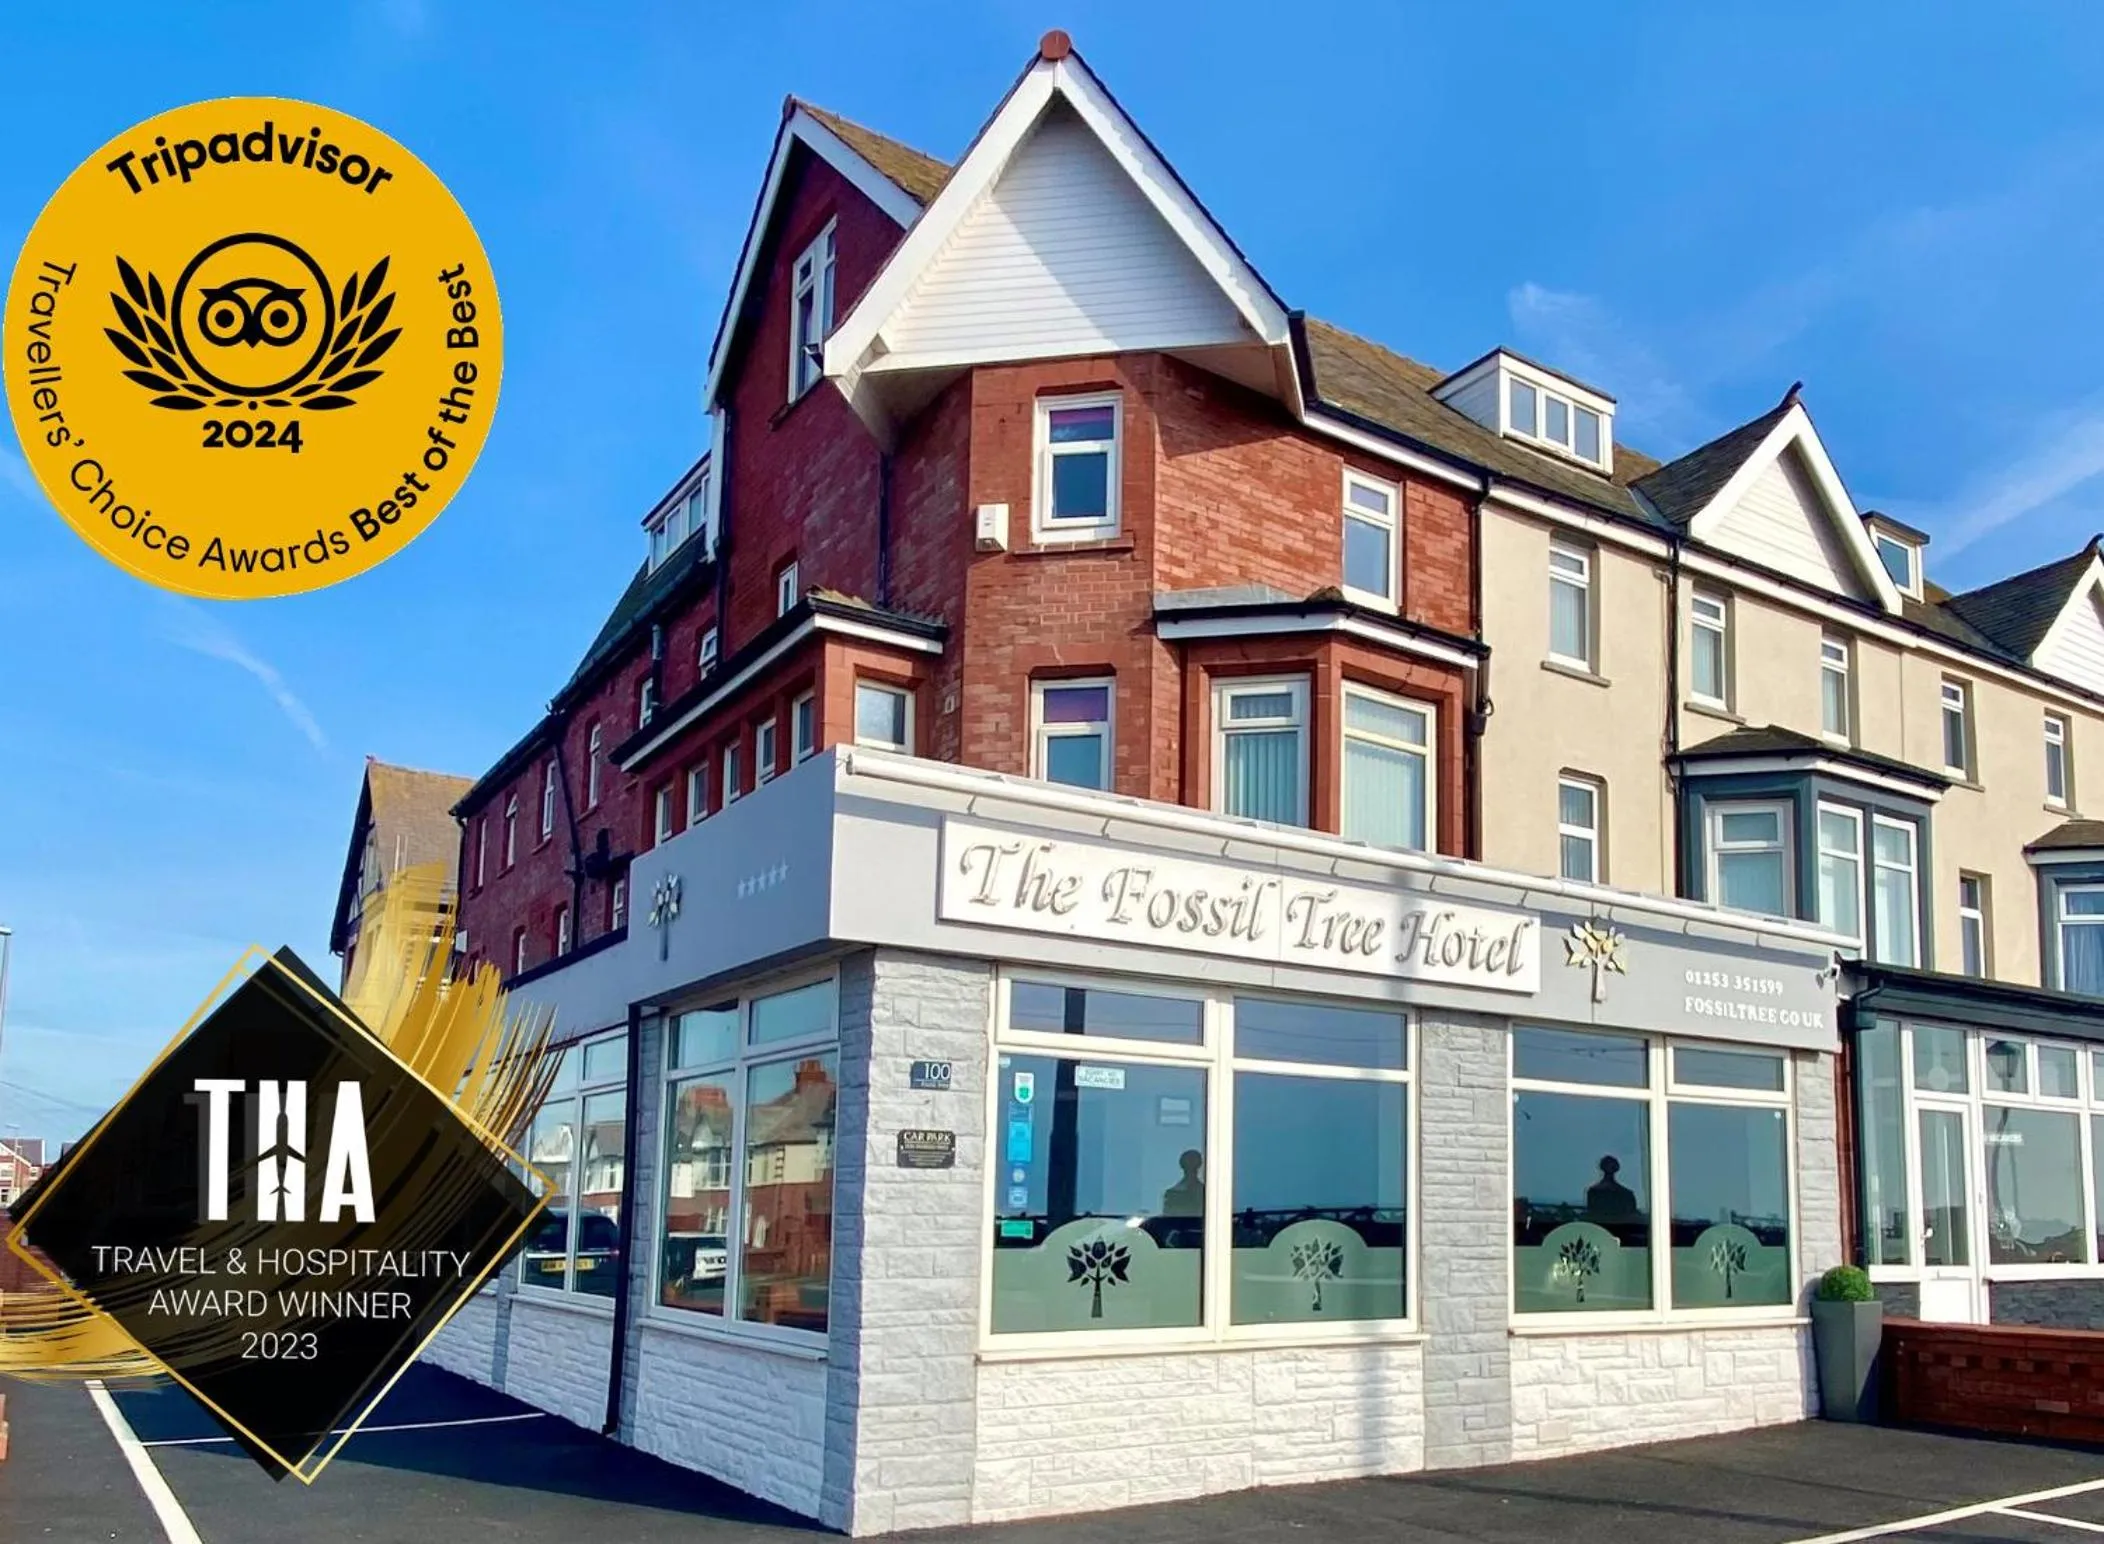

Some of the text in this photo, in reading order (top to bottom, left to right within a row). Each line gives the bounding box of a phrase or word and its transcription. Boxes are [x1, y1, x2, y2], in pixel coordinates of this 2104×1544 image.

[960, 841, 1534, 977] The Fossil Tree Hotel
[1733, 975, 1784, 997] 351599
[924, 1062, 951, 1081] 100
[903, 1131, 951, 1144] CAR PARK
